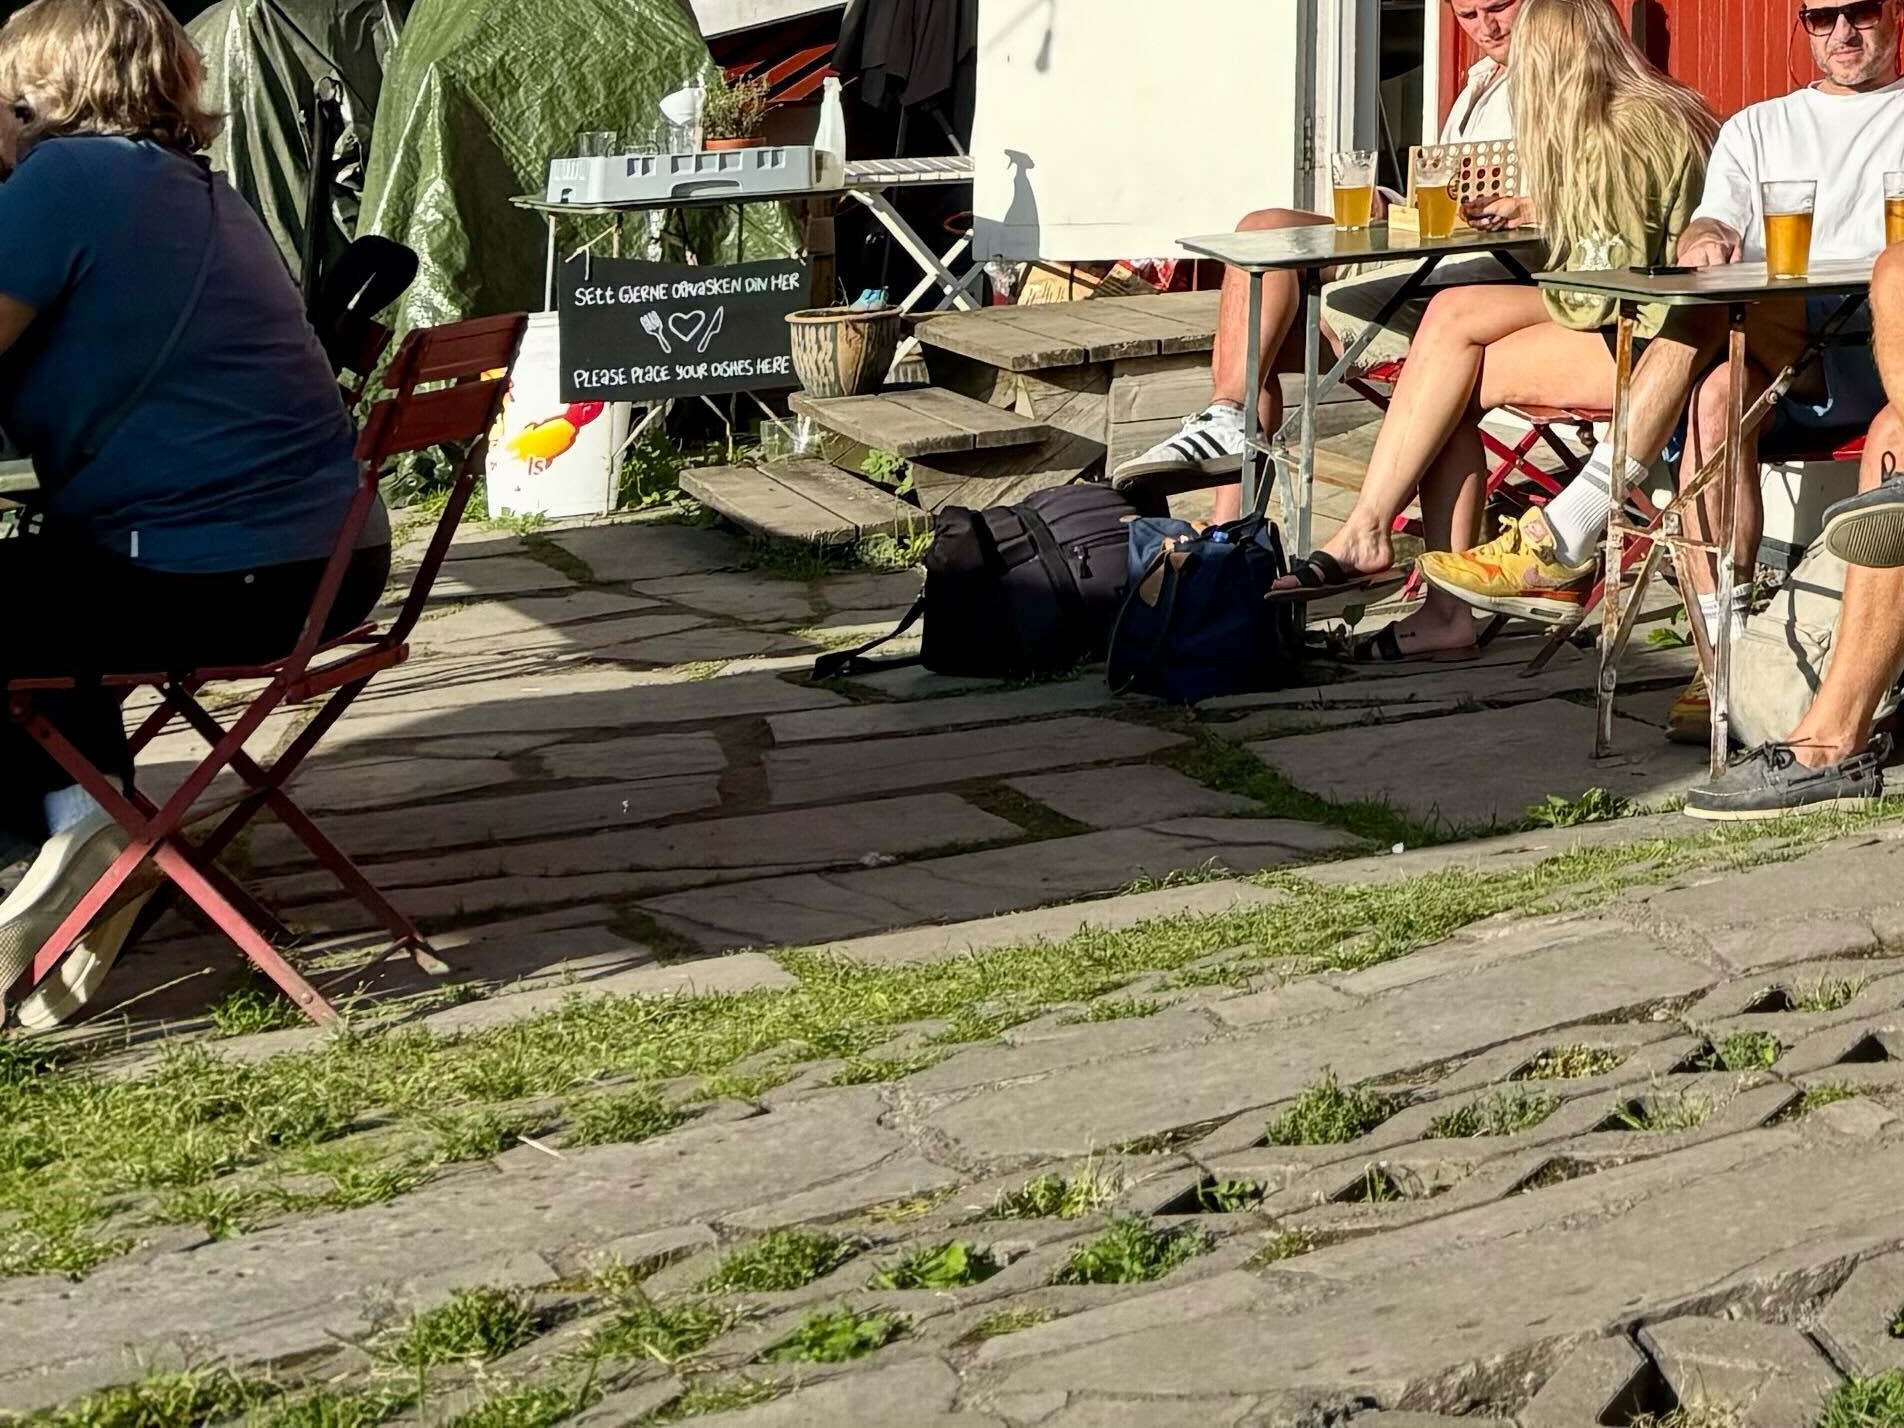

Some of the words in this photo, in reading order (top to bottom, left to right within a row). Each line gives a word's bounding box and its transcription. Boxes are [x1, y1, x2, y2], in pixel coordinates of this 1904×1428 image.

[618, 283, 669, 304] GJERNE
[770, 272, 800, 292] HER
[756, 355, 791, 375] HERE
